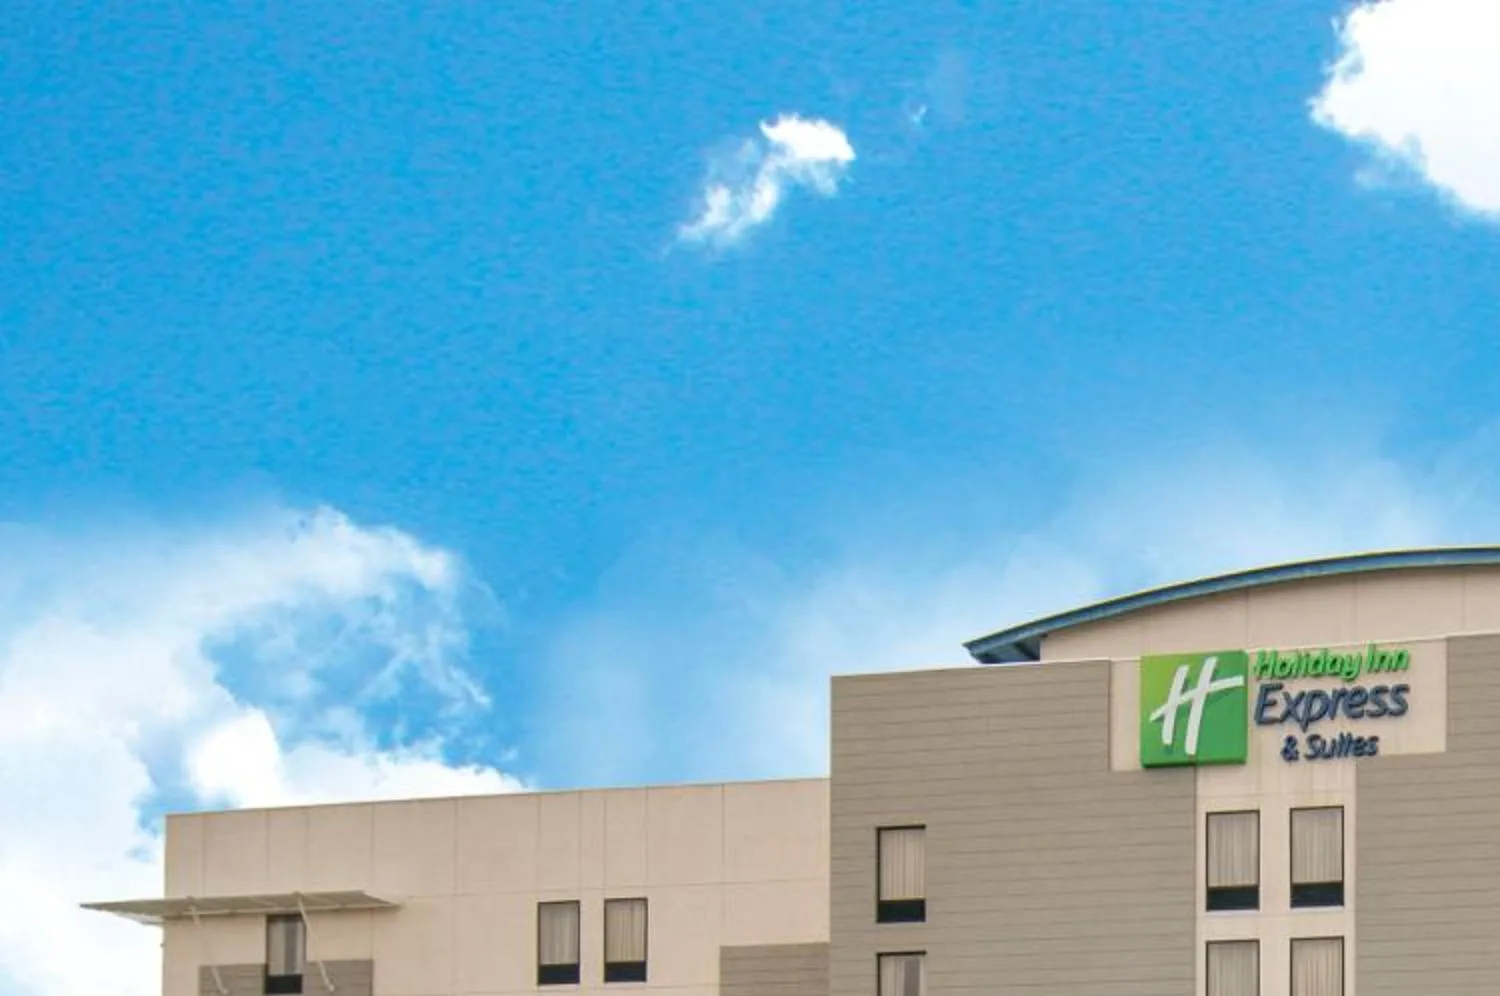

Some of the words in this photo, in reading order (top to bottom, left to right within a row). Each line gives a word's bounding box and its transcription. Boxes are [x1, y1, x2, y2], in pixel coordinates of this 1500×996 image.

[1254, 650, 1361, 681] Holiday
[1366, 642, 1409, 673] Inn
[1254, 682, 1410, 732] Express
[1281, 735, 1299, 762] &
[1304, 732, 1379, 761] Suites
